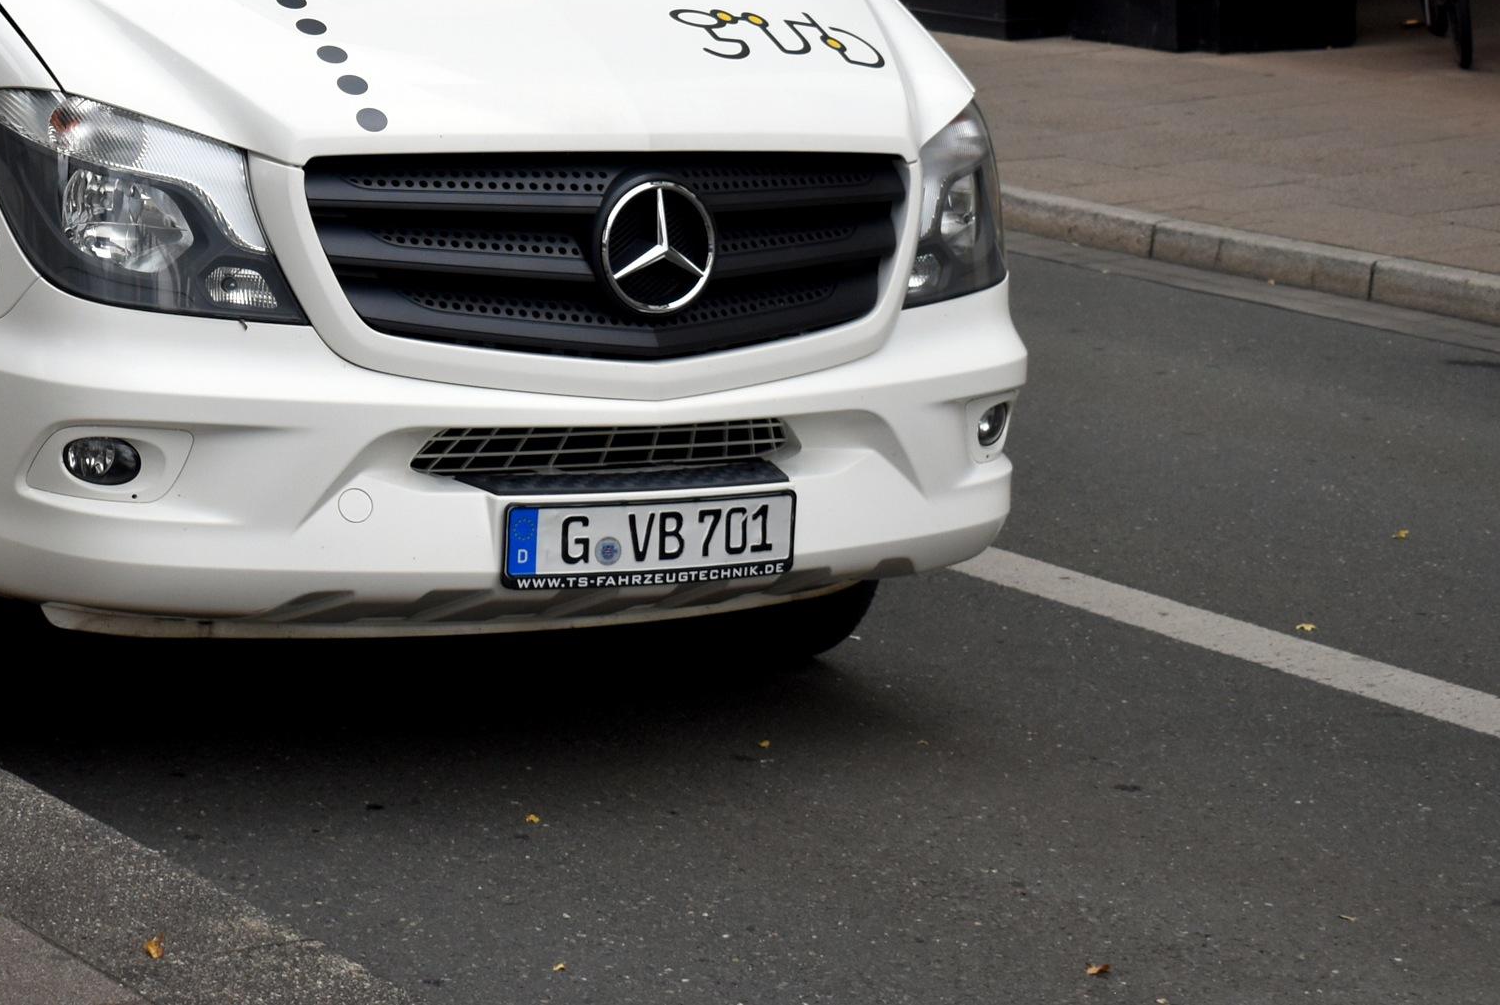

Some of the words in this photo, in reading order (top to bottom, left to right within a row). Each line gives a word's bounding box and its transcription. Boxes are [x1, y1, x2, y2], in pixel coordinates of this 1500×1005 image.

[561, 515, 590, 564] G
[628, 511, 685, 562] VB
[698, 504, 773, 557] 701
[517, 549, 528, 564] D
[517, 562, 785, 589] WWW.TS-FAHRZEUGTECHNIK.DE
